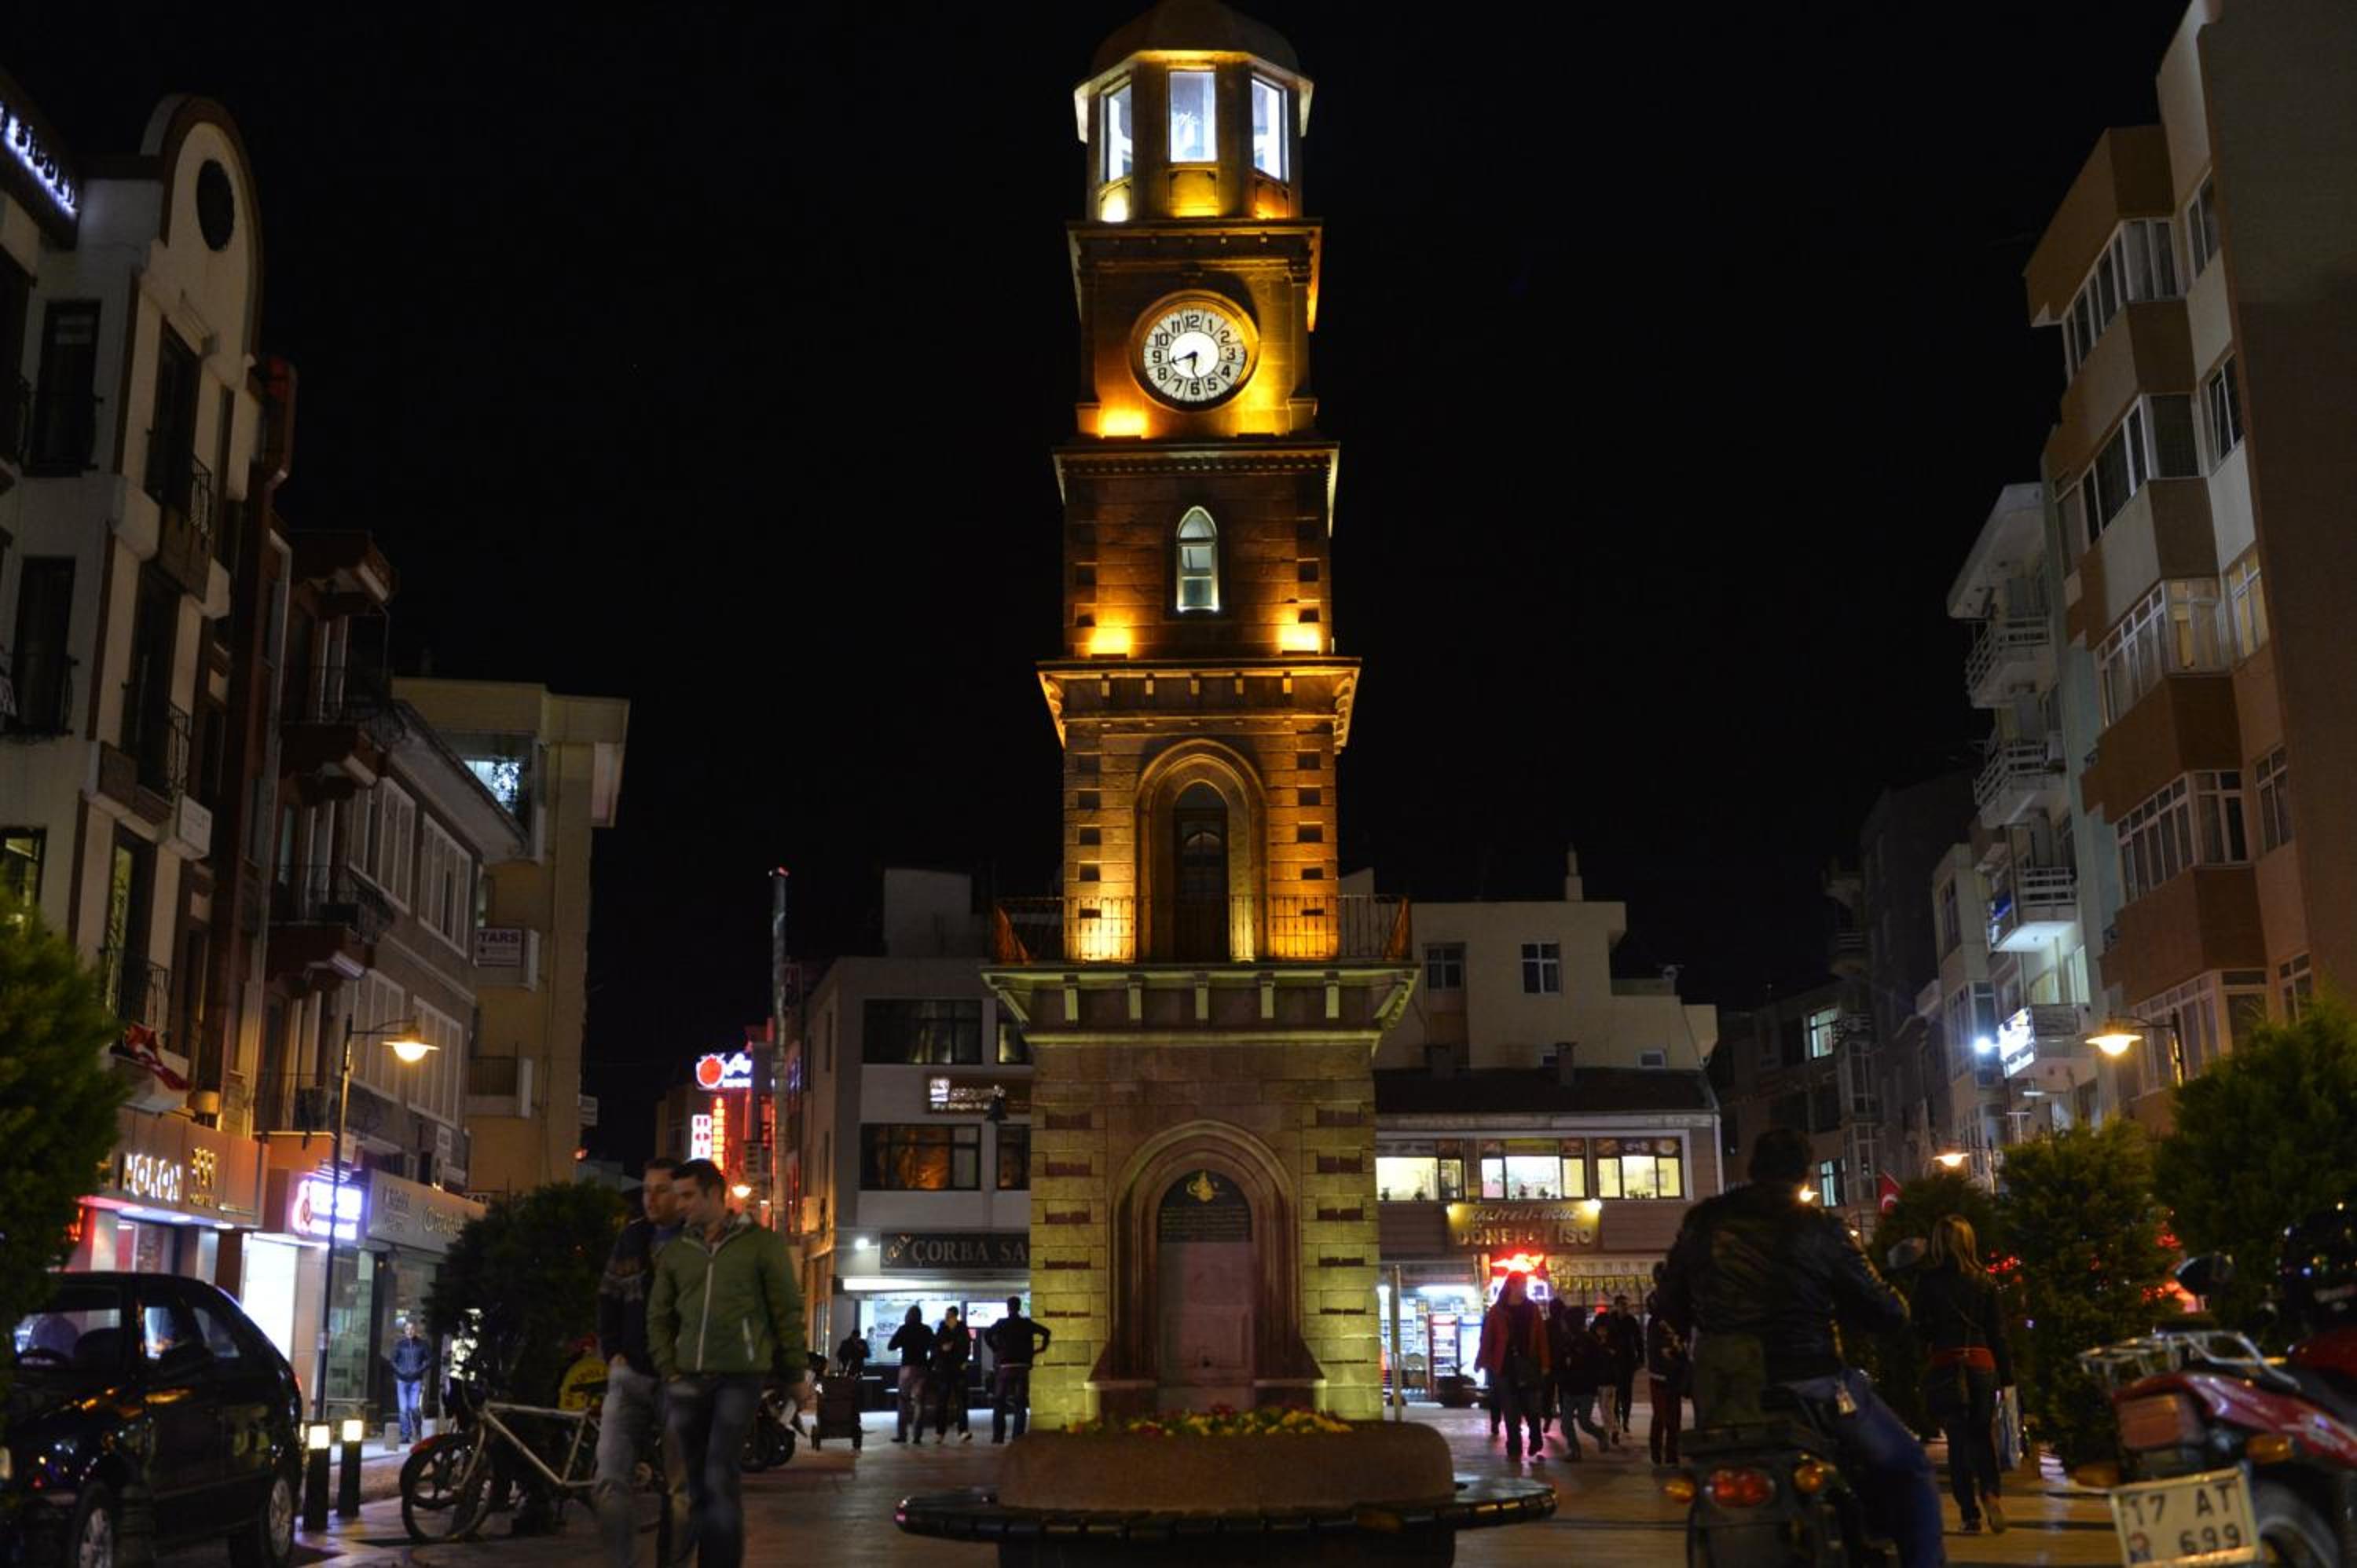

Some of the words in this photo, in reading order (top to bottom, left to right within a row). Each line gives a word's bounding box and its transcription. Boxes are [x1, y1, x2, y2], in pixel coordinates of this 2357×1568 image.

[1171, 321, 1181, 334] 11
[1186, 314, 1200, 328] 12
[1208, 319, 1213, 332] 1
[1154, 333, 1168, 346] 10
[1220, 330, 1230, 343] 2
[1152, 350, 1162, 364] 9
[1226, 347, 1236, 361] 3
[1157, 367, 1168, 381] 8
[1221, 365, 1231, 378] 4
[1173, 379, 1183, 392] 7
[1190, 381, 1200, 395] 6
[1207, 378, 1218, 390] 5
[911, 1240, 991, 1267] ÇORBA
[2130, 1493, 2165, 1526] 17
[2195, 1483, 2233, 1519] AT
[2179, 1524, 2240, 1555] 699
